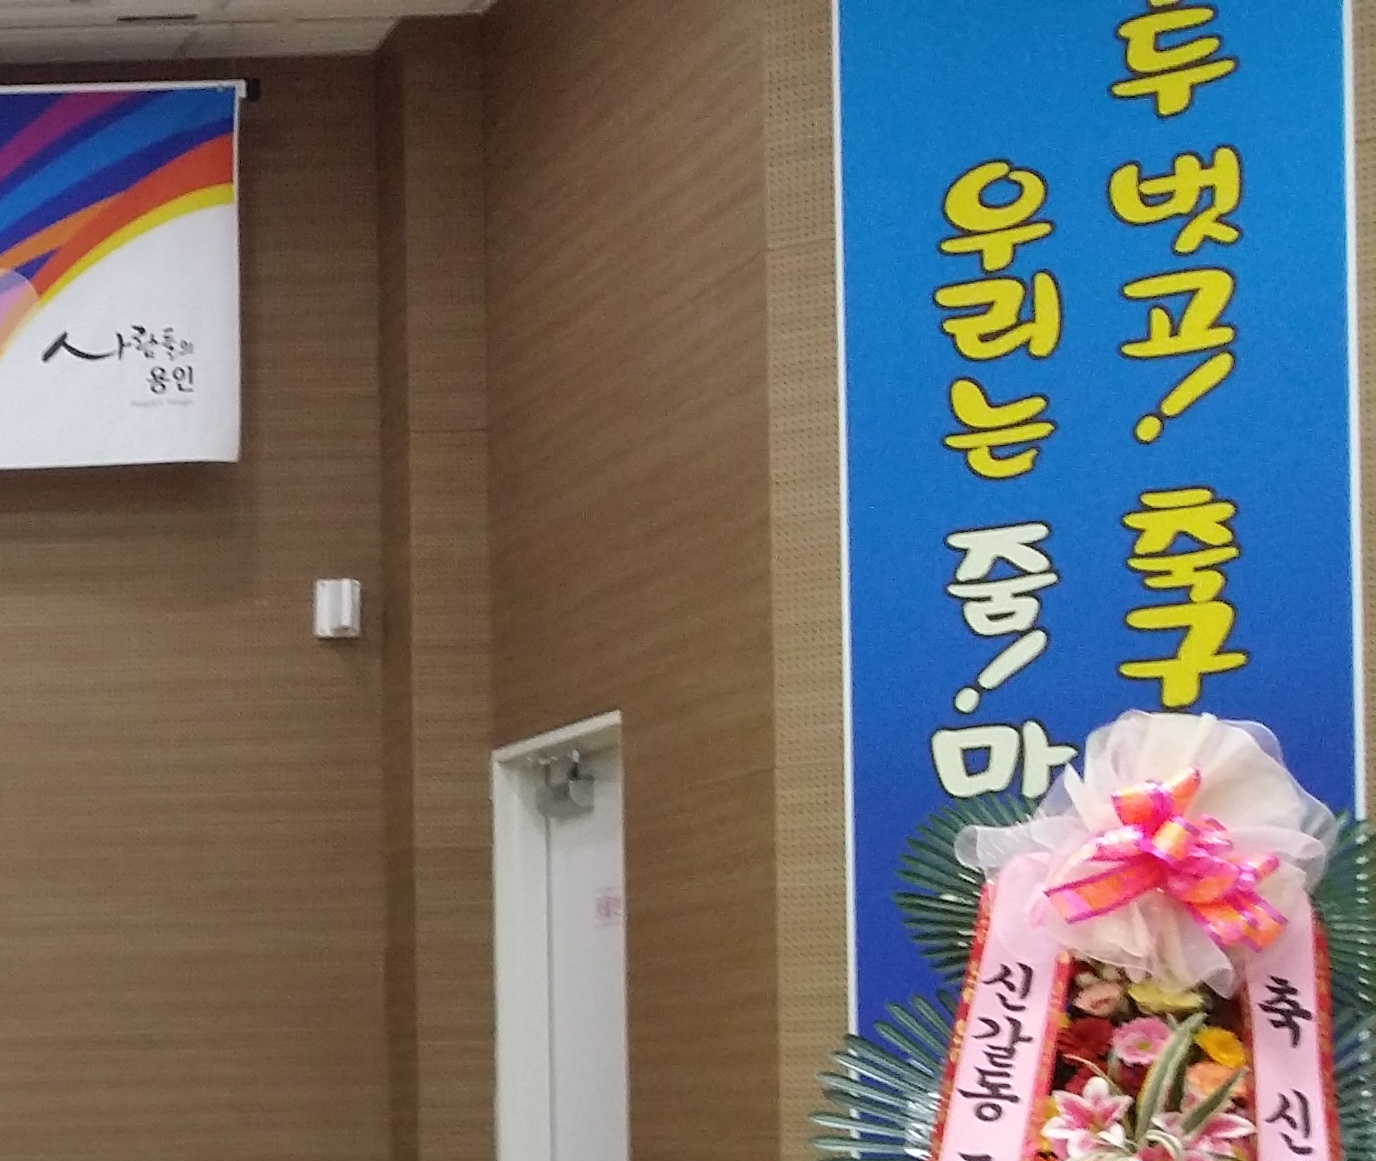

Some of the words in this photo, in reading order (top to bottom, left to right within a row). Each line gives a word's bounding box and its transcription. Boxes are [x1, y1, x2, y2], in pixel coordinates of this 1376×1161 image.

[1109, 0, 1240, 119] 두
[932, 157, 1064, 480] 우리는
[1107, 143, 1243, 444] 벗고!
[145, 364, 195, 396] 용인
[1116, 486, 1250, 711] 축구
[955, 961, 1034, 1124] 신갈동
[1258, 976, 1313, 1048] 축
